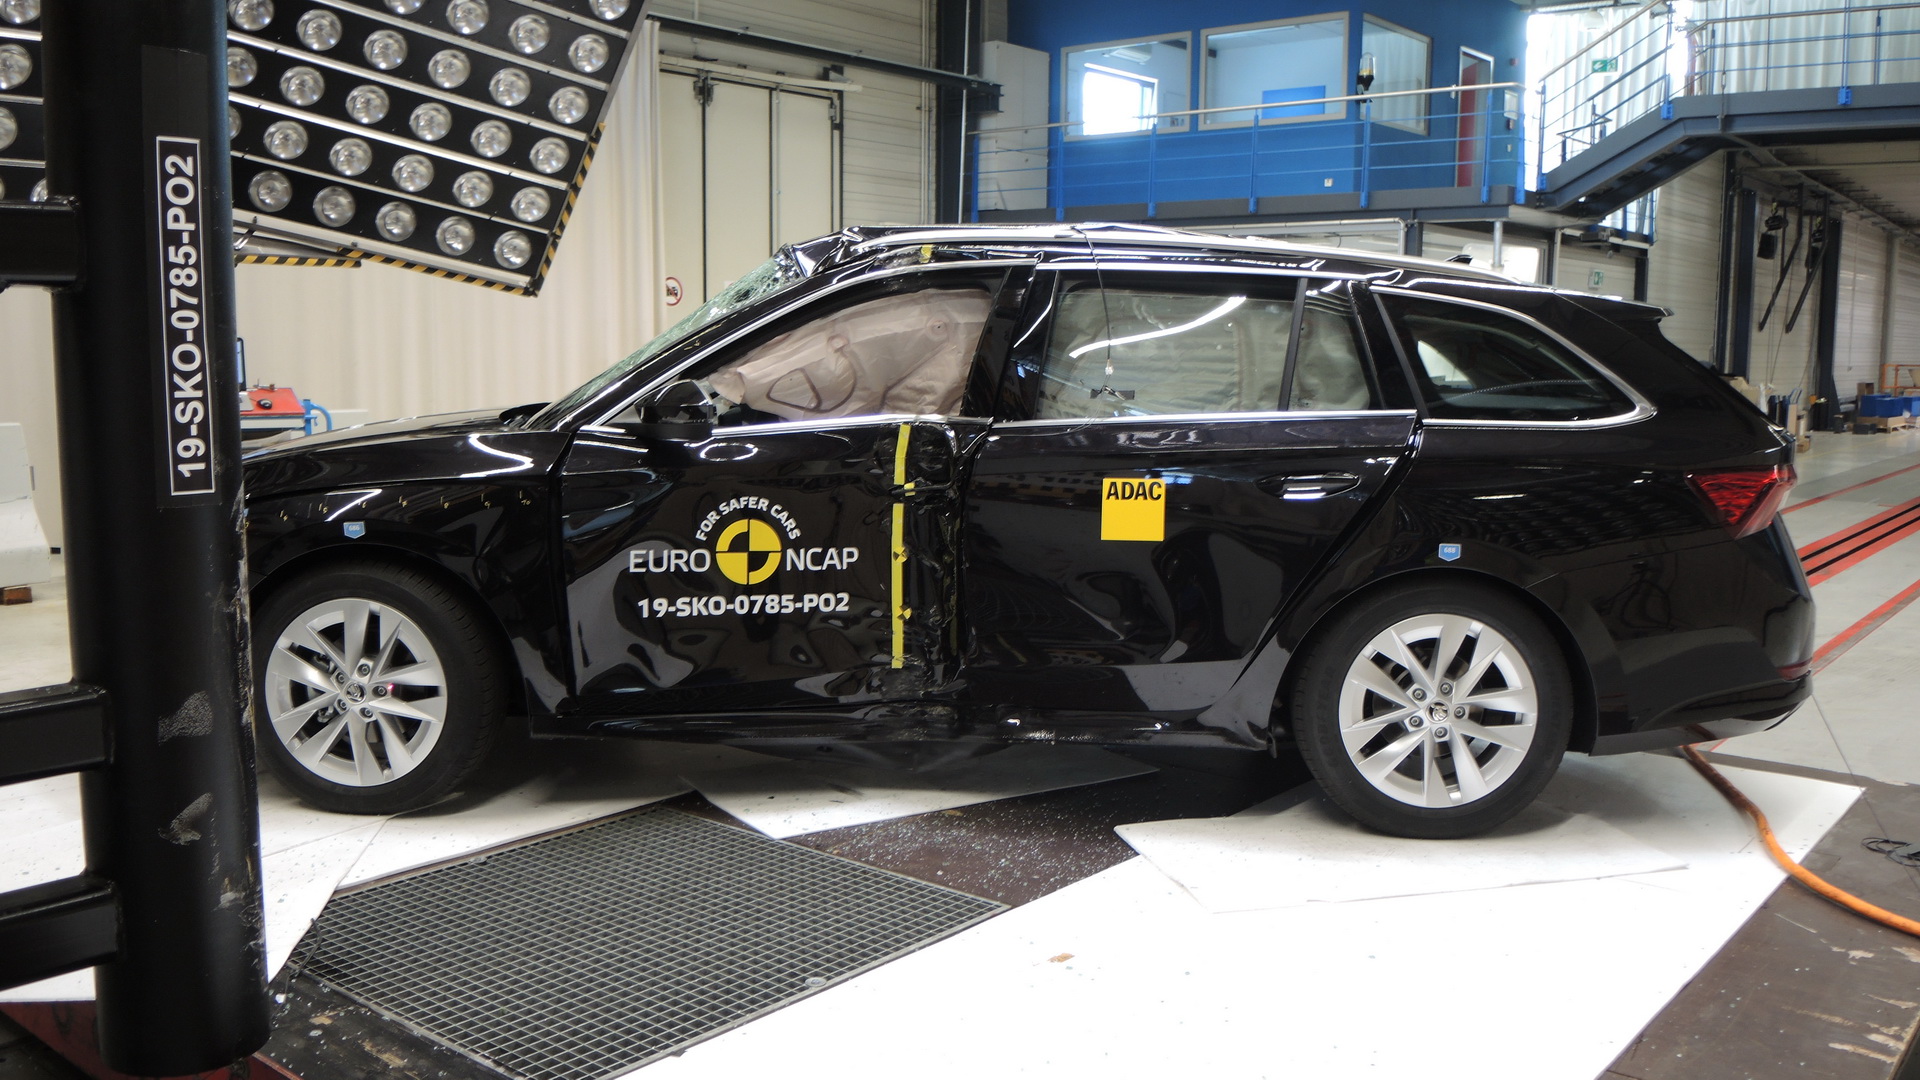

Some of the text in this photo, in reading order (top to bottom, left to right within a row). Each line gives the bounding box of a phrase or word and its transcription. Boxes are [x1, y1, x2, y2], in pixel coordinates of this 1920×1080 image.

[164, 154, 207, 478] 19-SKO-0785-PO2
[1105, 481, 1162, 501] ADAC
[695, 496, 801, 542] FOR SAFER CARS
[629, 547, 859, 573] EURO NCAP
[637, 592, 850, 619] 19-SKO-0785-PO2
